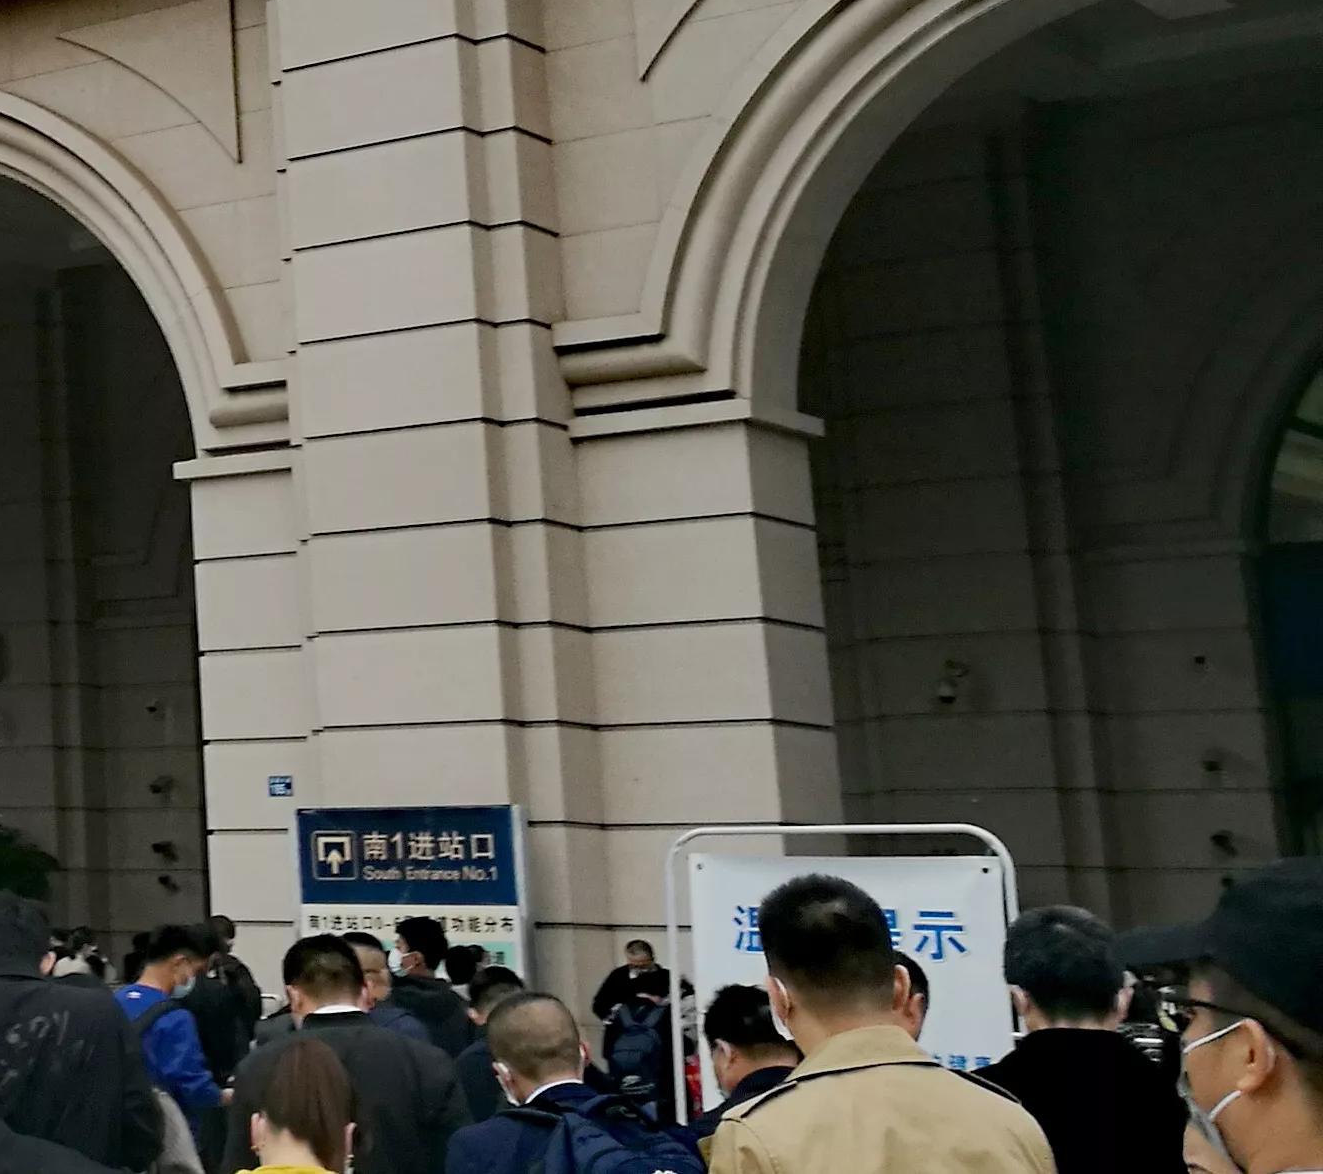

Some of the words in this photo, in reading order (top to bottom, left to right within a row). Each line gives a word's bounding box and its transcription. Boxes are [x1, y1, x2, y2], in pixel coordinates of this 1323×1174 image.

[362, 831, 495, 861] 南1进站口
[362, 865, 402, 880] South
[405, 865, 461, 881] Entrance
